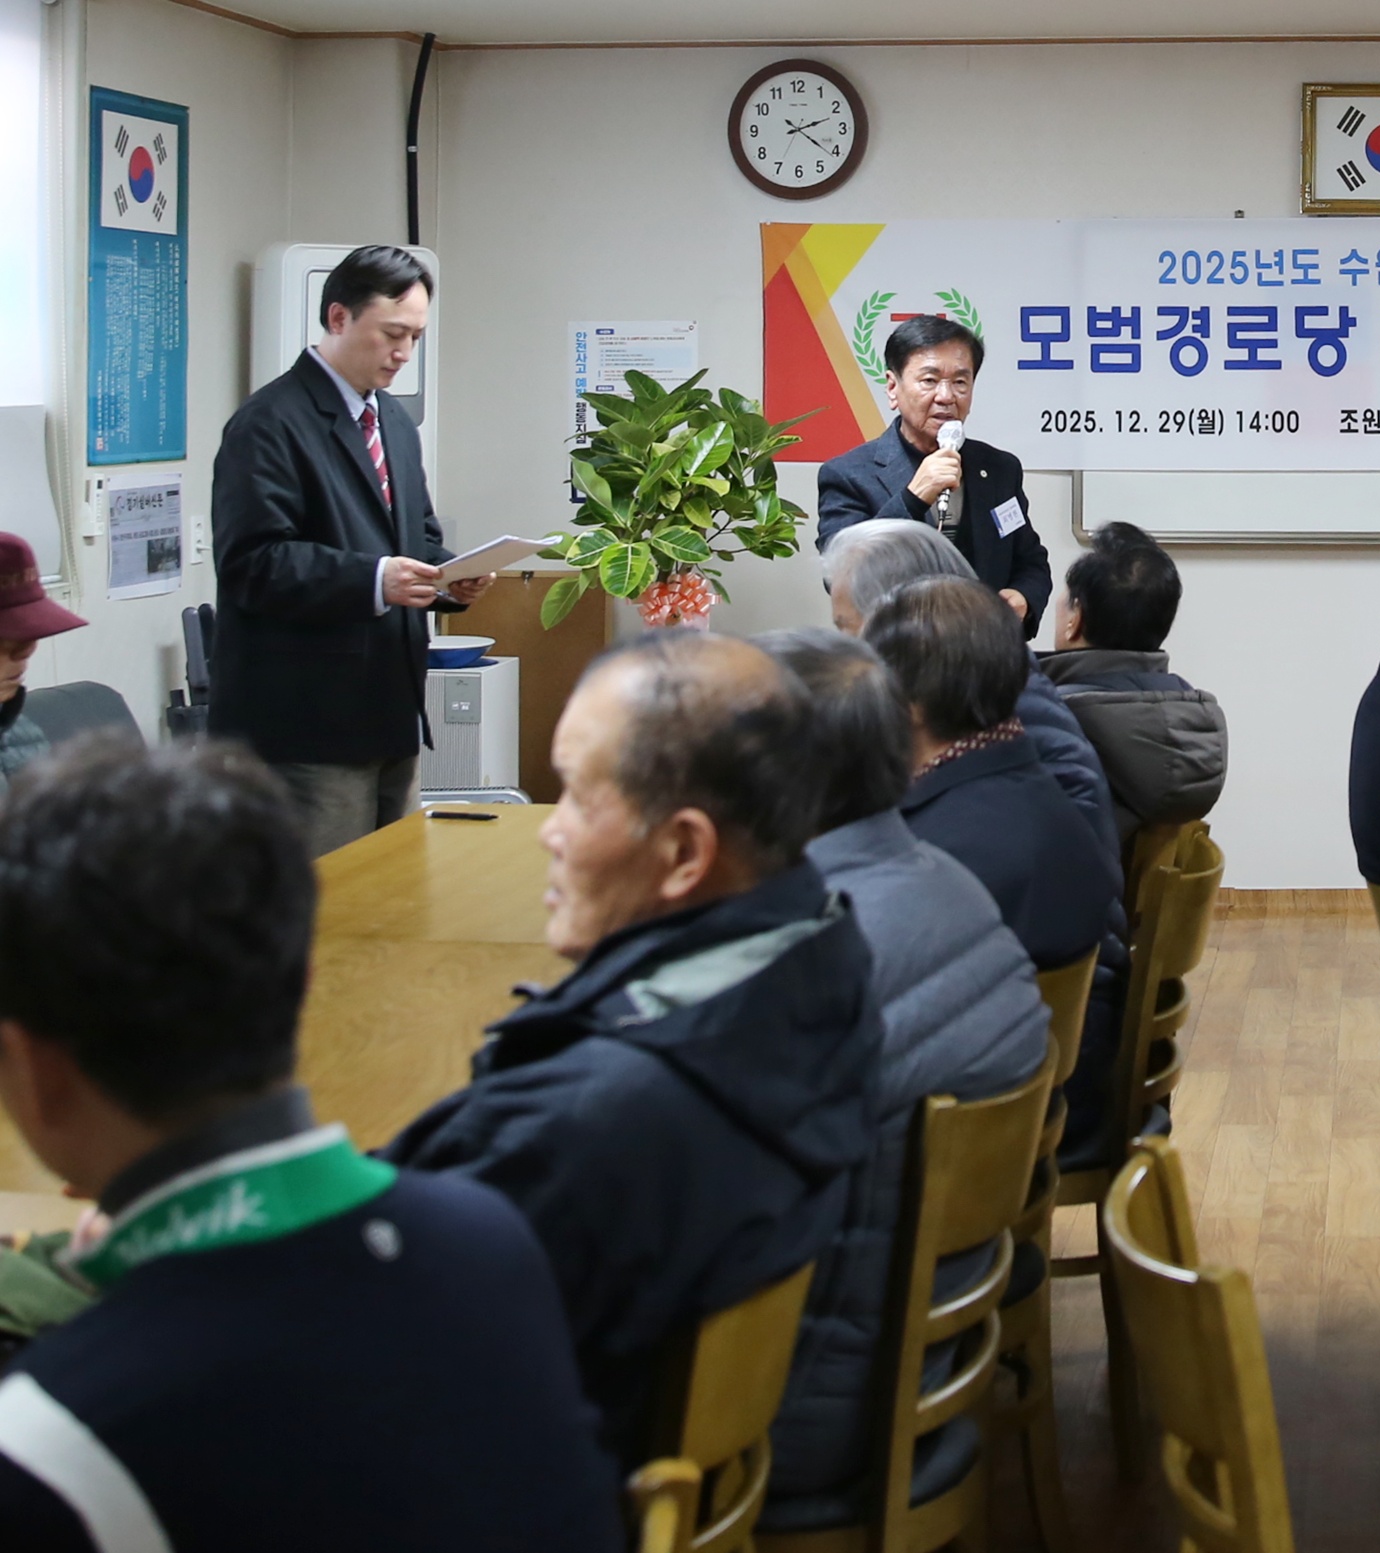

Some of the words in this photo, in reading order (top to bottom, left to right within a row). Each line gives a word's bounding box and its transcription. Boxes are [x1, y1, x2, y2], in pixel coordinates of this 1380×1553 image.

[770, 87, 782, 99] 11
[790, 80, 805, 93] 12
[817, 86, 823, 98] 1
[755, 103, 769, 116] 10
[831, 101, 840, 113] 2
[750, 125, 758, 137] 9
[838, 122, 847, 135] 3
[758, 147, 766, 159] 8
[831, 145, 840, 157] 4
[774, 162, 783, 174] 7
[795, 165, 803, 178] 6
[816, 160, 824, 173] 5
[1159, 249, 1322, 287] 2025년도
[1018, 306, 1357, 377] 모범경로당
[1042, 410, 1103, 433] 2025.
[1115, 411, 1148, 433] 12.
[1159, 408, 1224, 436] 29(월)
[1236, 410, 1300, 433] 14:00
